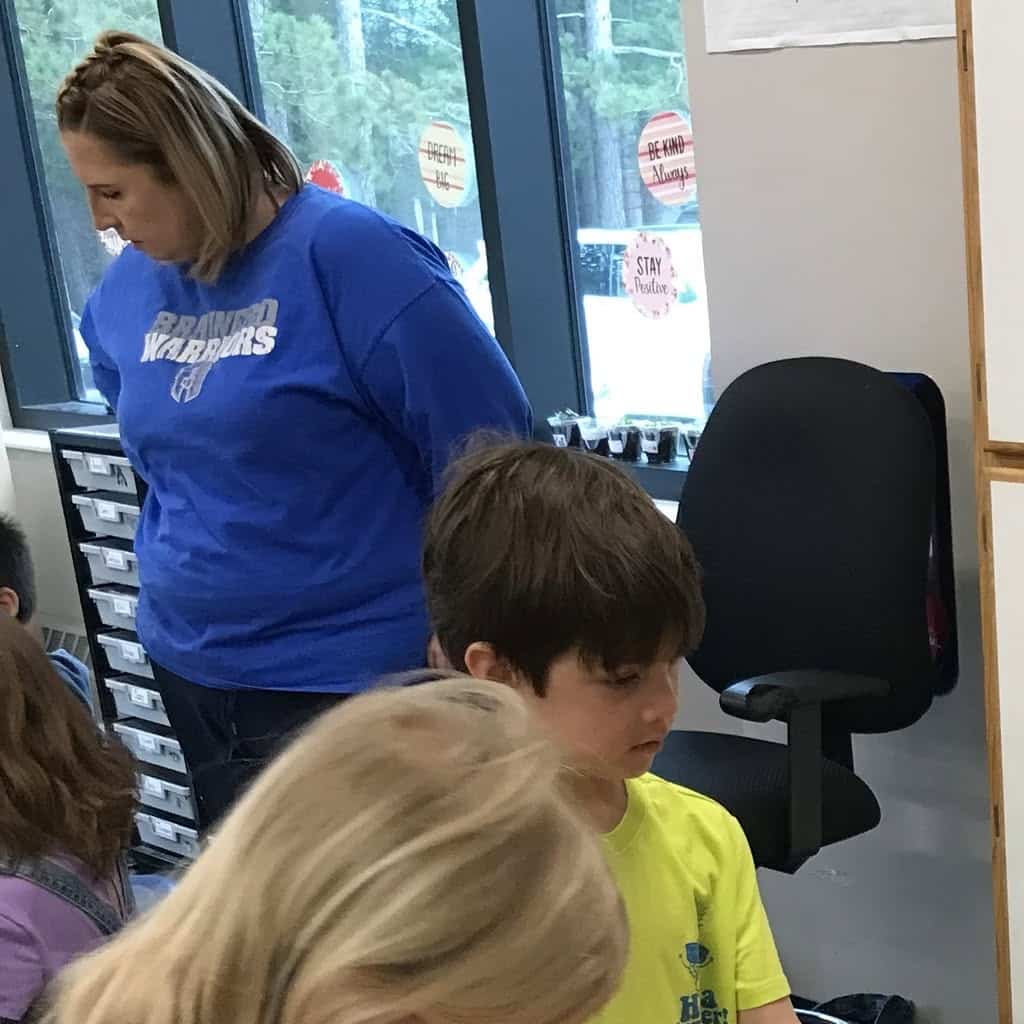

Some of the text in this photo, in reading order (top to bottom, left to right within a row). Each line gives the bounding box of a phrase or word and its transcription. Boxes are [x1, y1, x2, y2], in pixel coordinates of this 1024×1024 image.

[427, 141, 457, 168] DREAM
[647, 135, 685, 161] BE KIND
[435, 169, 450, 192] BIG
[652, 163, 689, 191] Always
[636, 255, 662, 277] STAY
[634, 276, 669, 295] Positive
